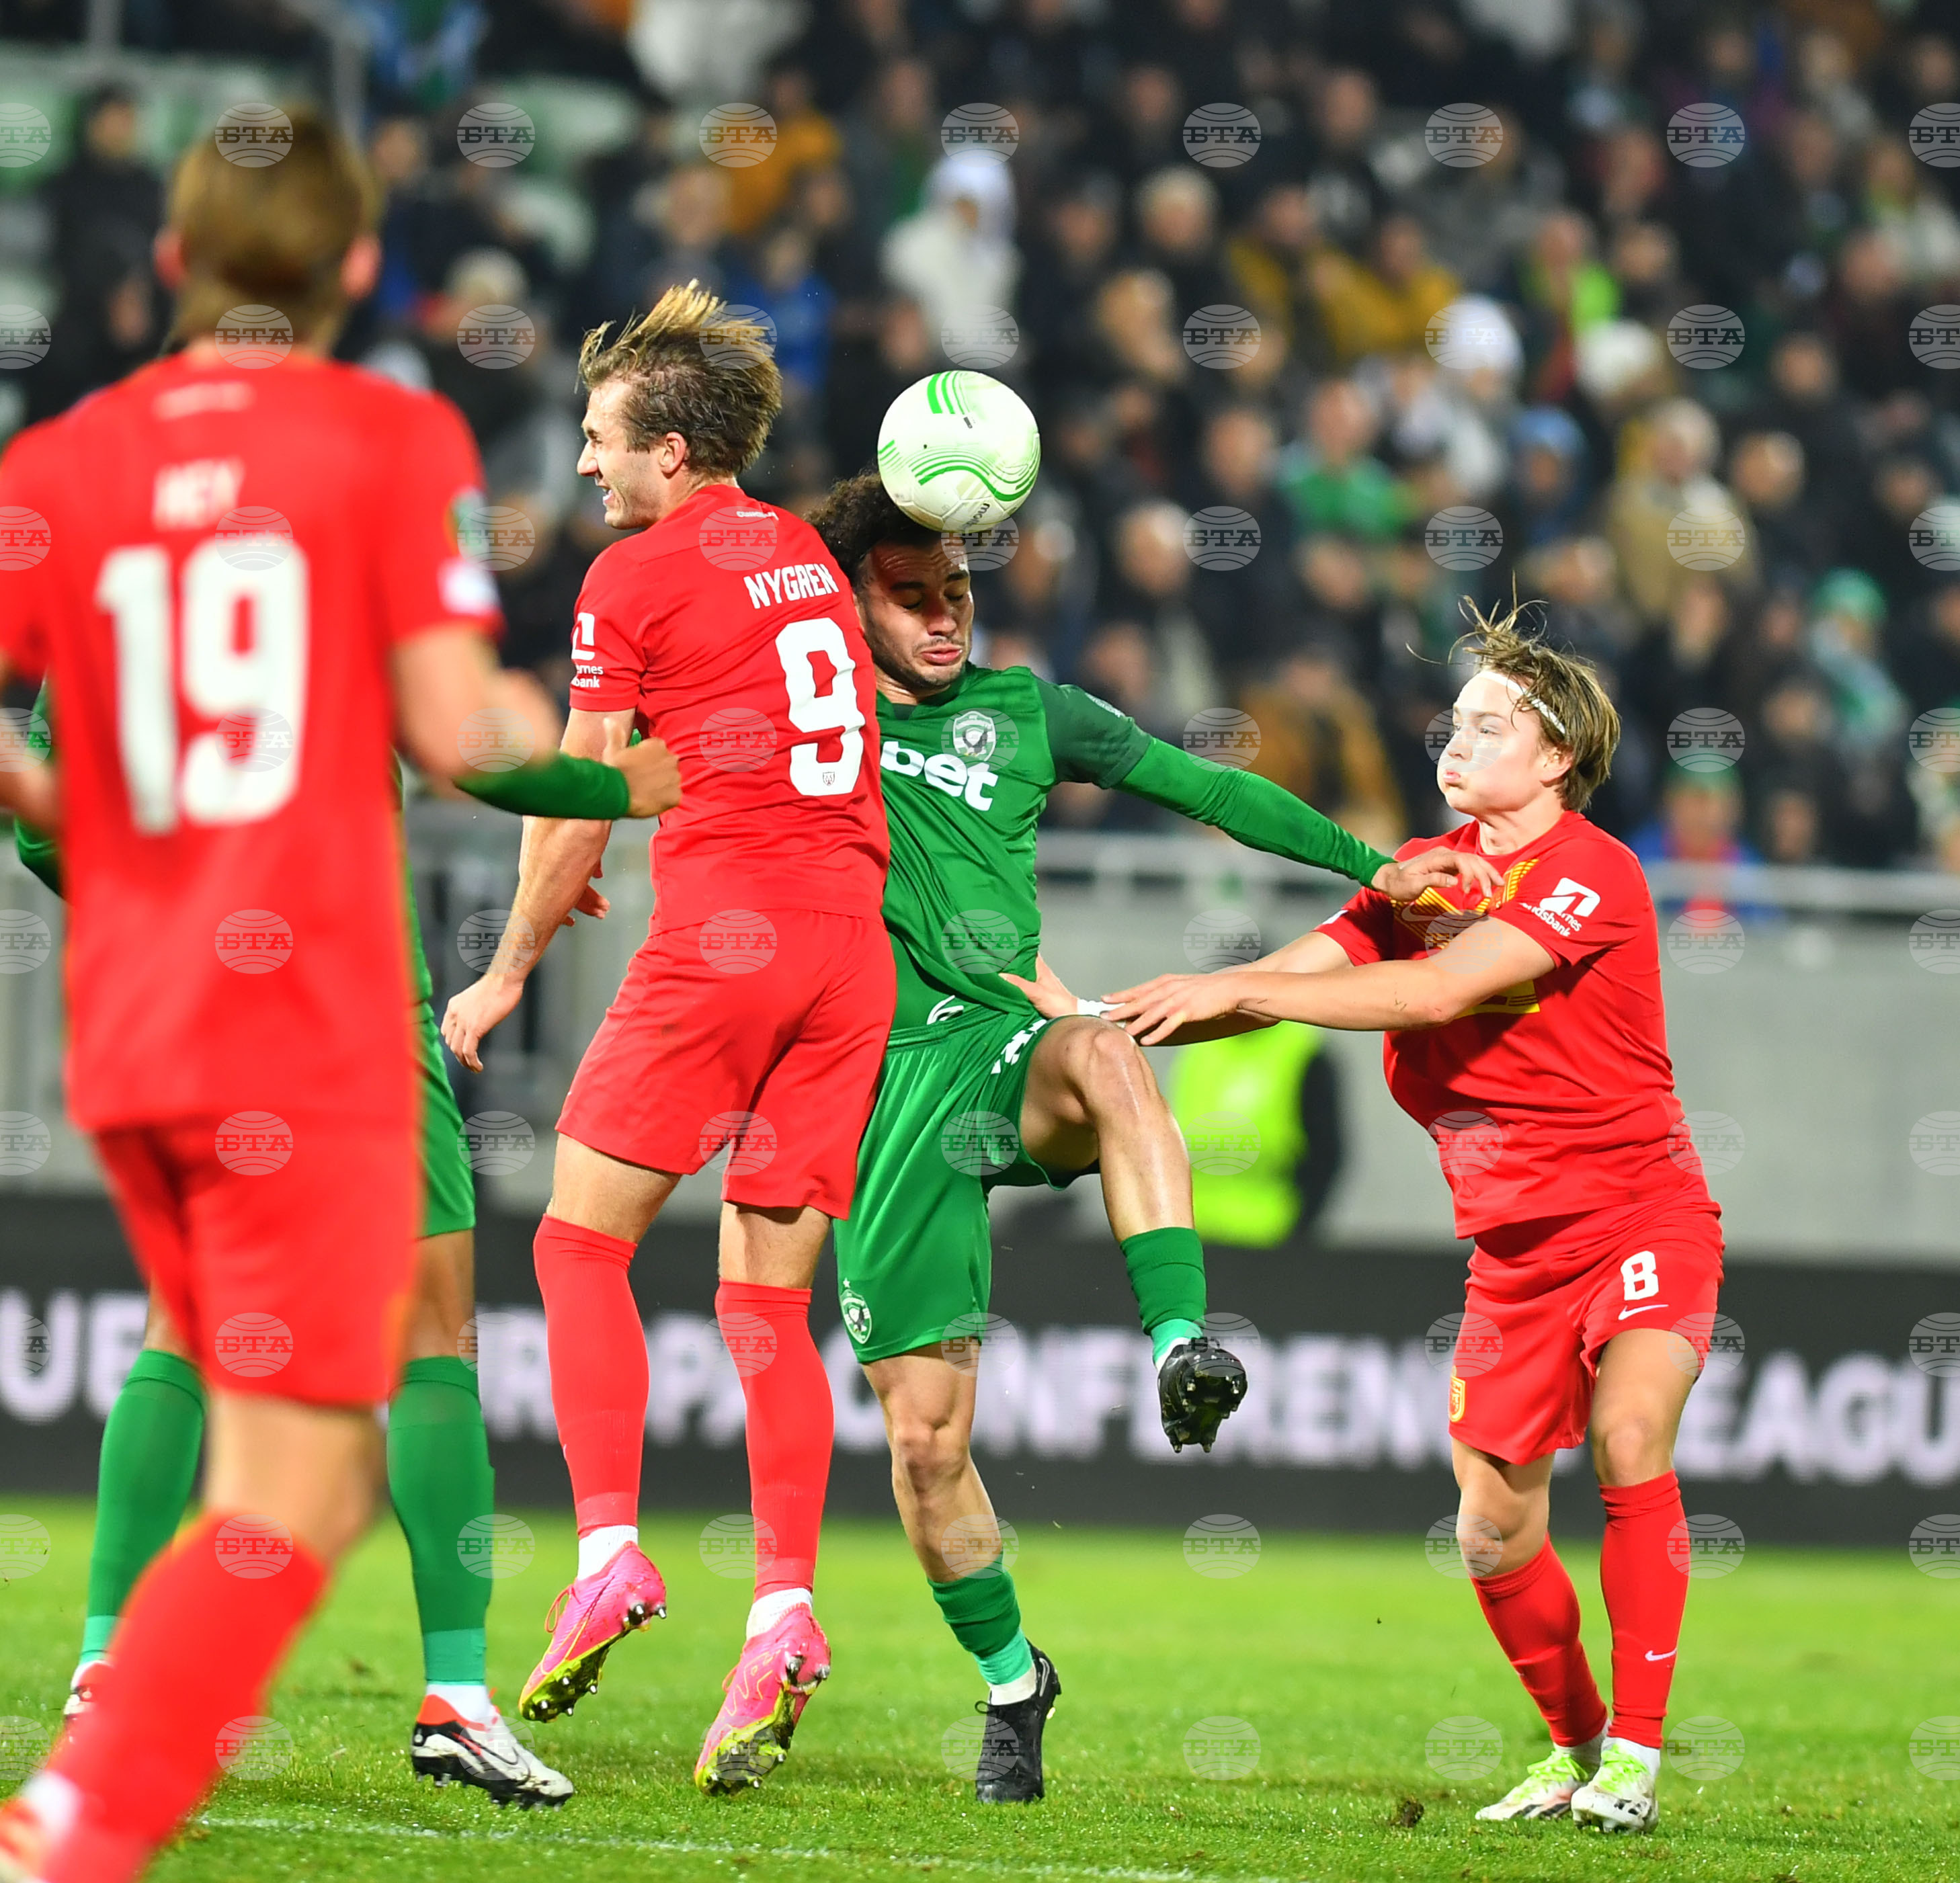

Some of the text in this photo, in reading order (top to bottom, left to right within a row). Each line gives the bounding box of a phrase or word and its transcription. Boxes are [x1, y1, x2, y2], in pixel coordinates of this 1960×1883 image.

[743, 563, 840, 609] NYGREN
[96, 540, 310, 836] 19
[571, 675, 600, 688] bank
[775, 618, 865, 796] 9
[880, 741, 999, 811] bet
[1621, 1251, 1659, 1300] 8
[0, 1286, 149, 1423] UE
[1672, 1344, 1960, 1489] EAGU
